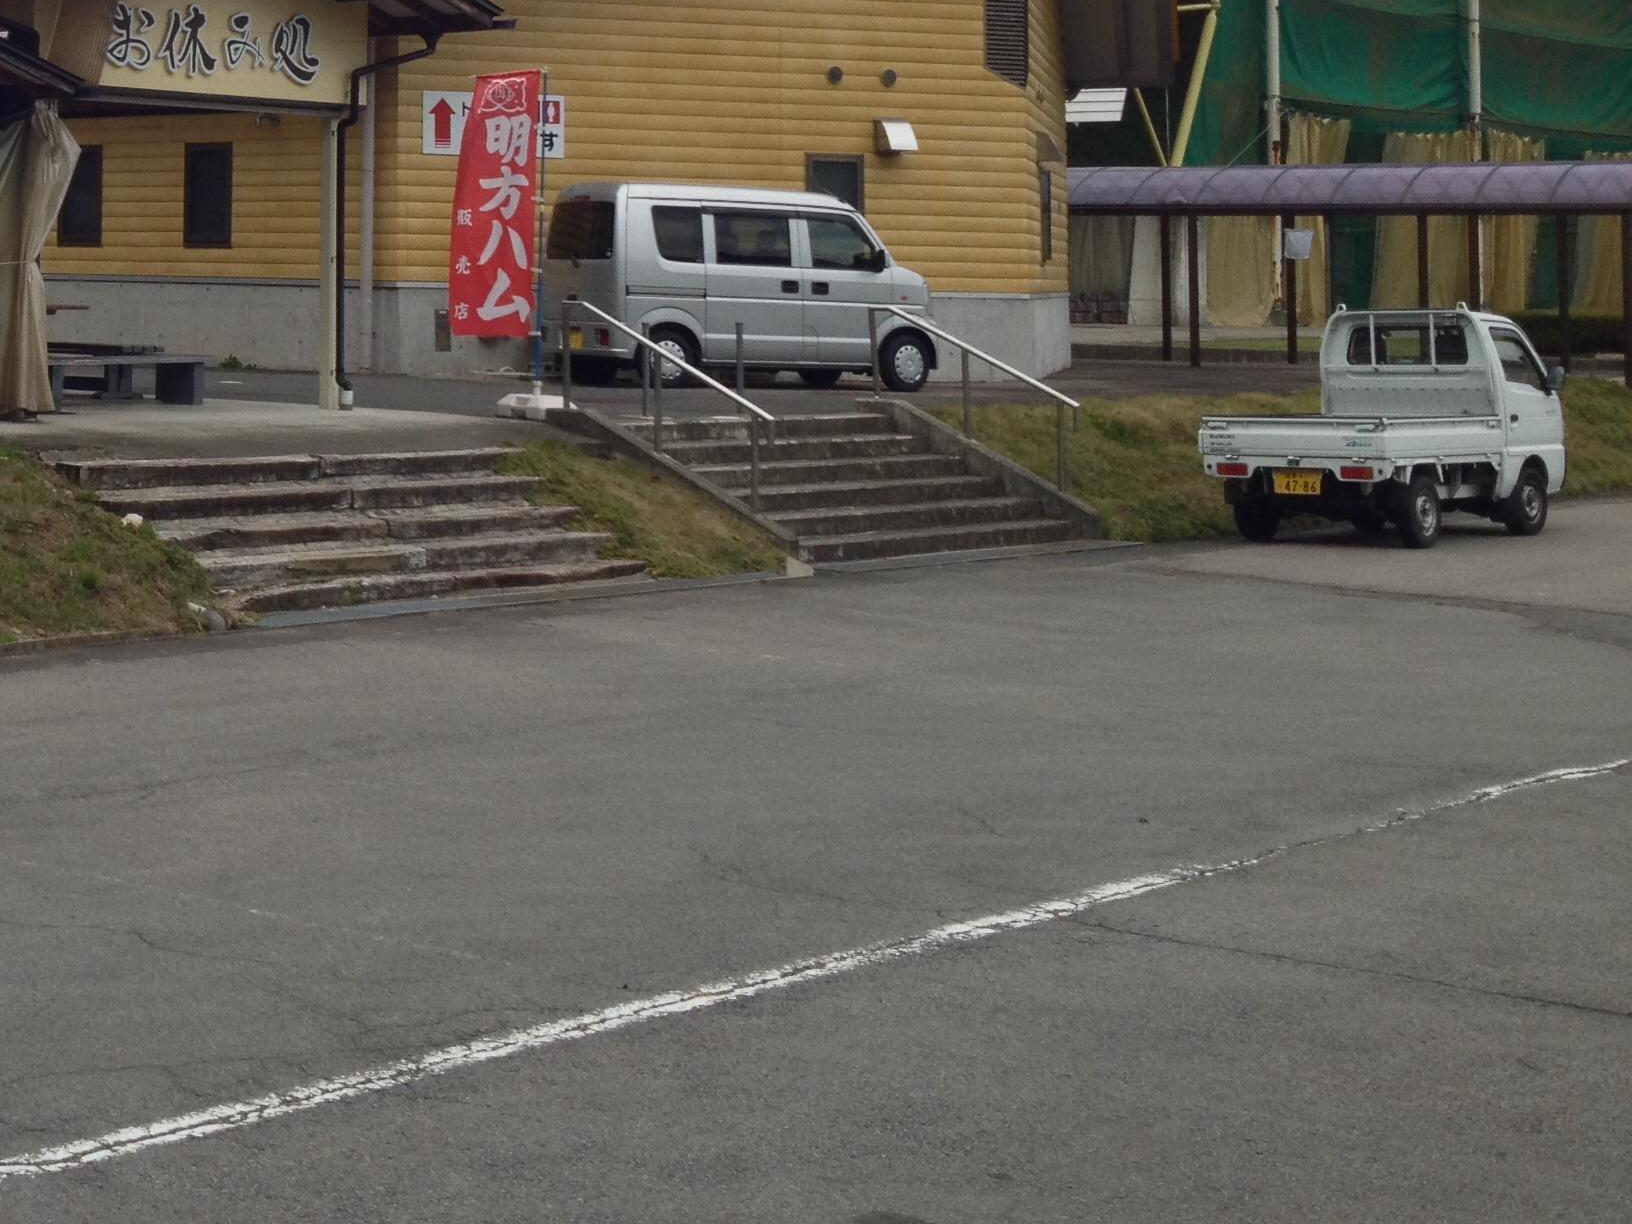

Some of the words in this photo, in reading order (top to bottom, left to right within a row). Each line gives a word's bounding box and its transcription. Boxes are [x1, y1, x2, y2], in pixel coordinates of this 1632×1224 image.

[106, 2, 319, 85] お休み処
[454, 208, 473, 321] 販売店
[476, 113, 532, 324] 明方ハム
